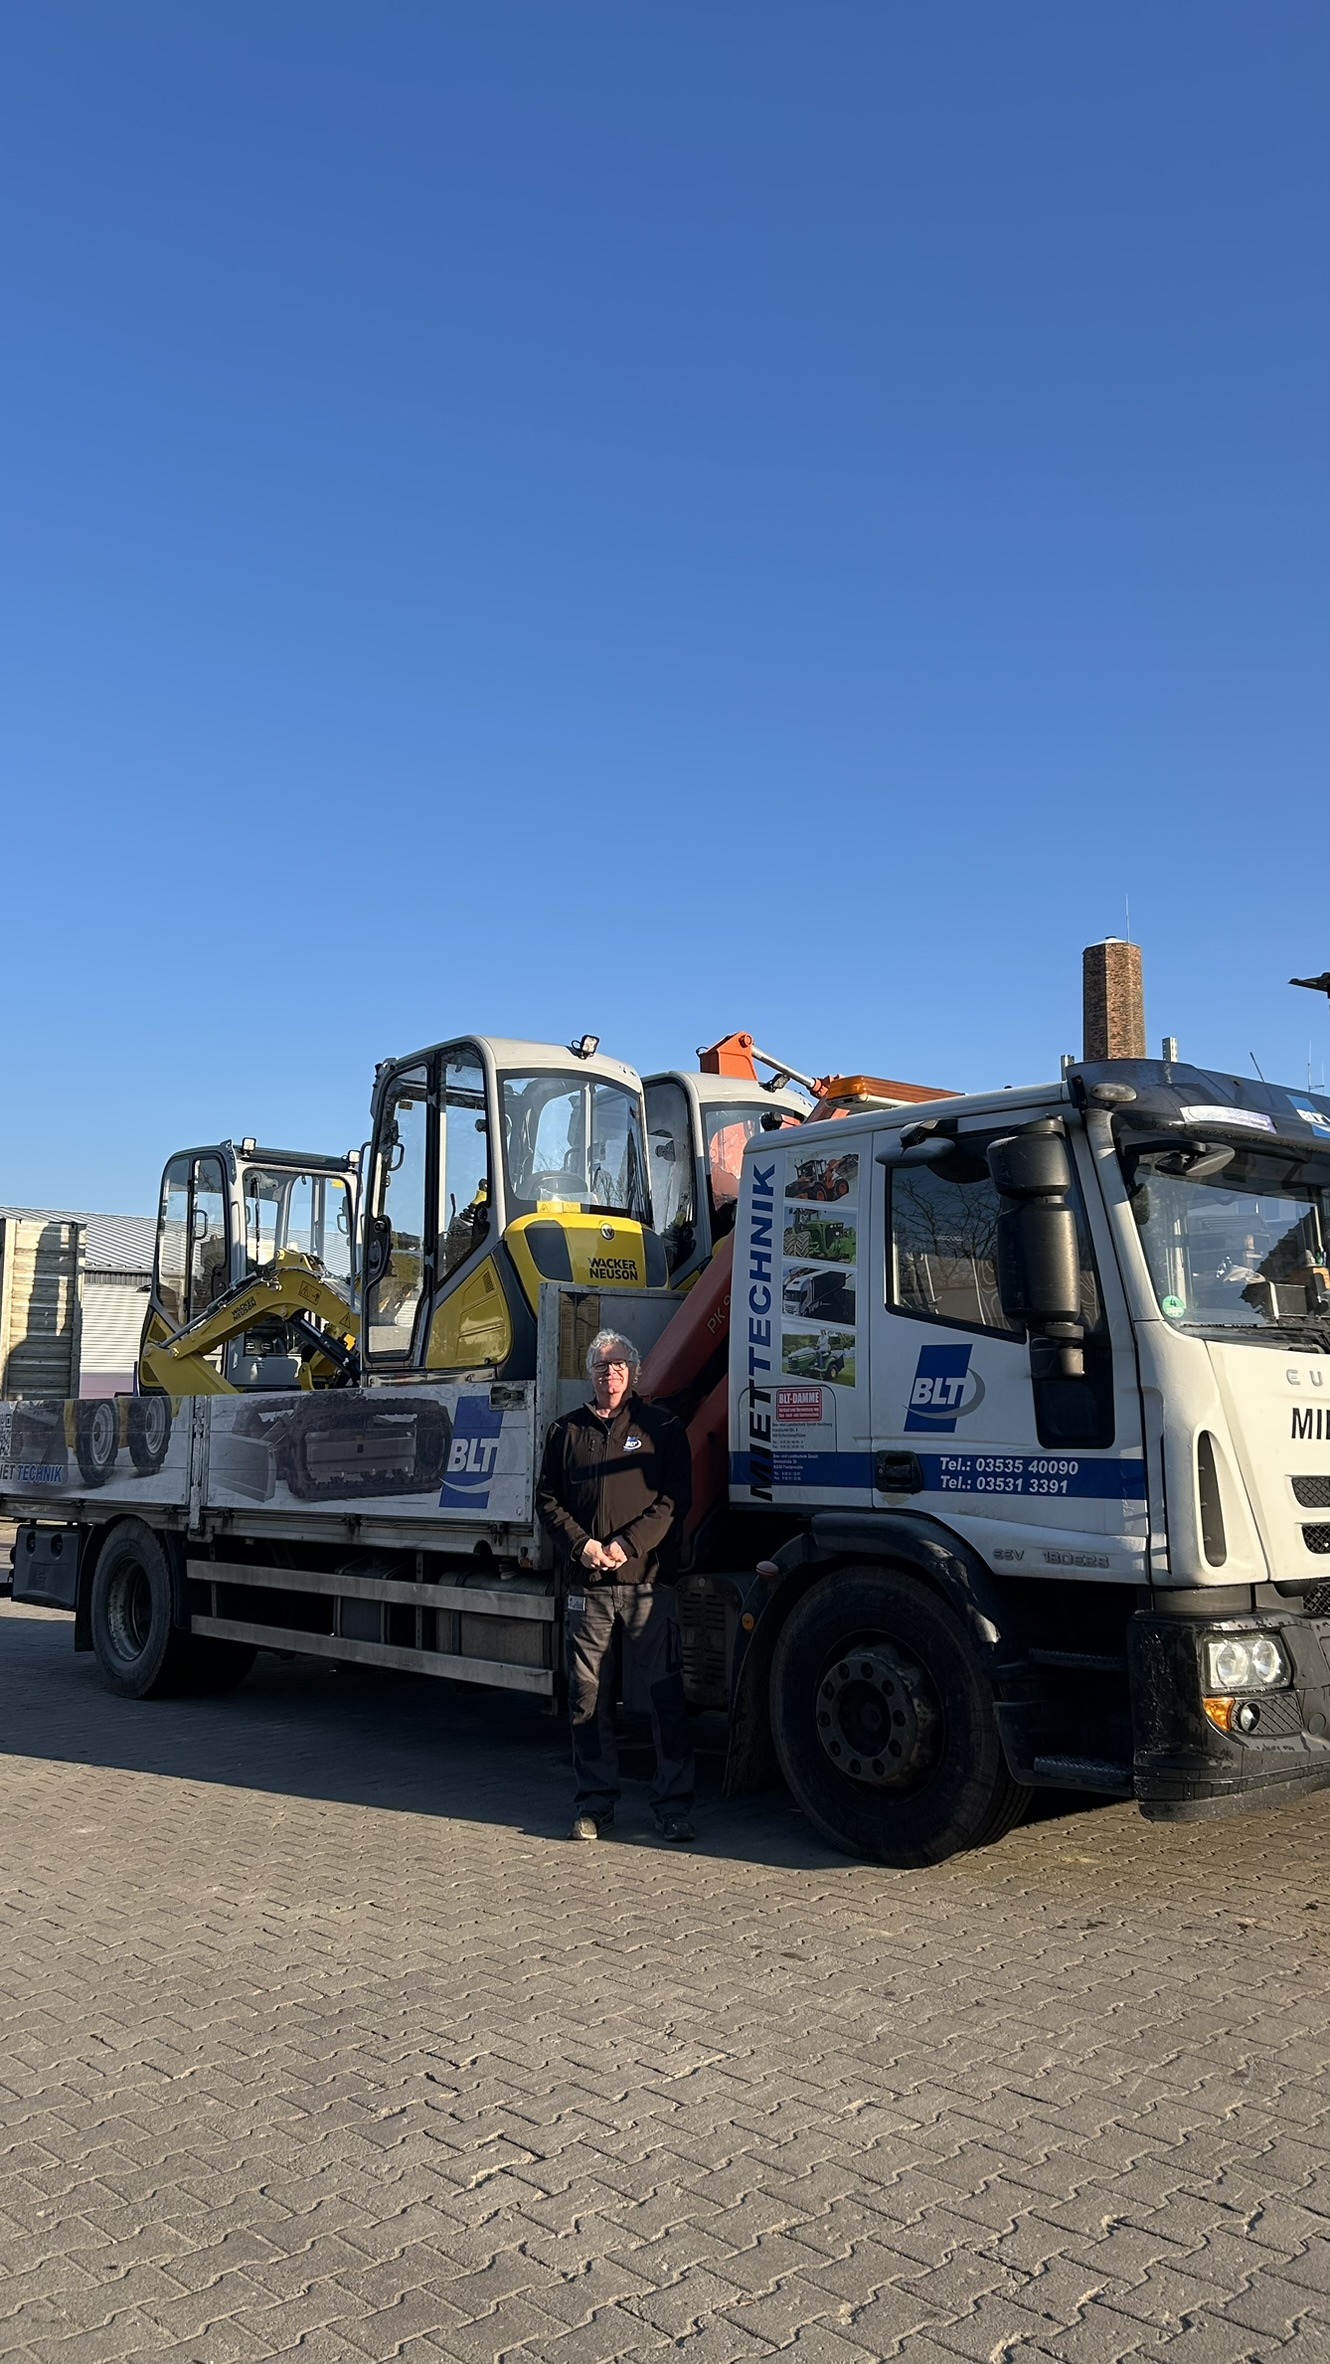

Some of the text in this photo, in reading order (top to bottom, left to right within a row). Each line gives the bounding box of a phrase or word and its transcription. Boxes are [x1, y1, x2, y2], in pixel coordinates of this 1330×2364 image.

[587, 1257, 637, 1271] WACKER
[589, 1267, 638, 1281] NEUSON
[231, 1296, 256, 1316] WACKER
[706, 1307, 727, 1335] PK
[778, 1392, 819, 1404] BLT-DAMME
[911, 1377, 967, 1406] BLT
[447, 1437, 500, 1473] BLT
[17, 1464, 63, 1483] TECHNIK
[939, 1457, 1079, 1476] Tel.: 03535 40090
[940, 1475, 1069, 1494] Tel.: 03531 3391
[993, 1548, 1025, 1561] EEV
